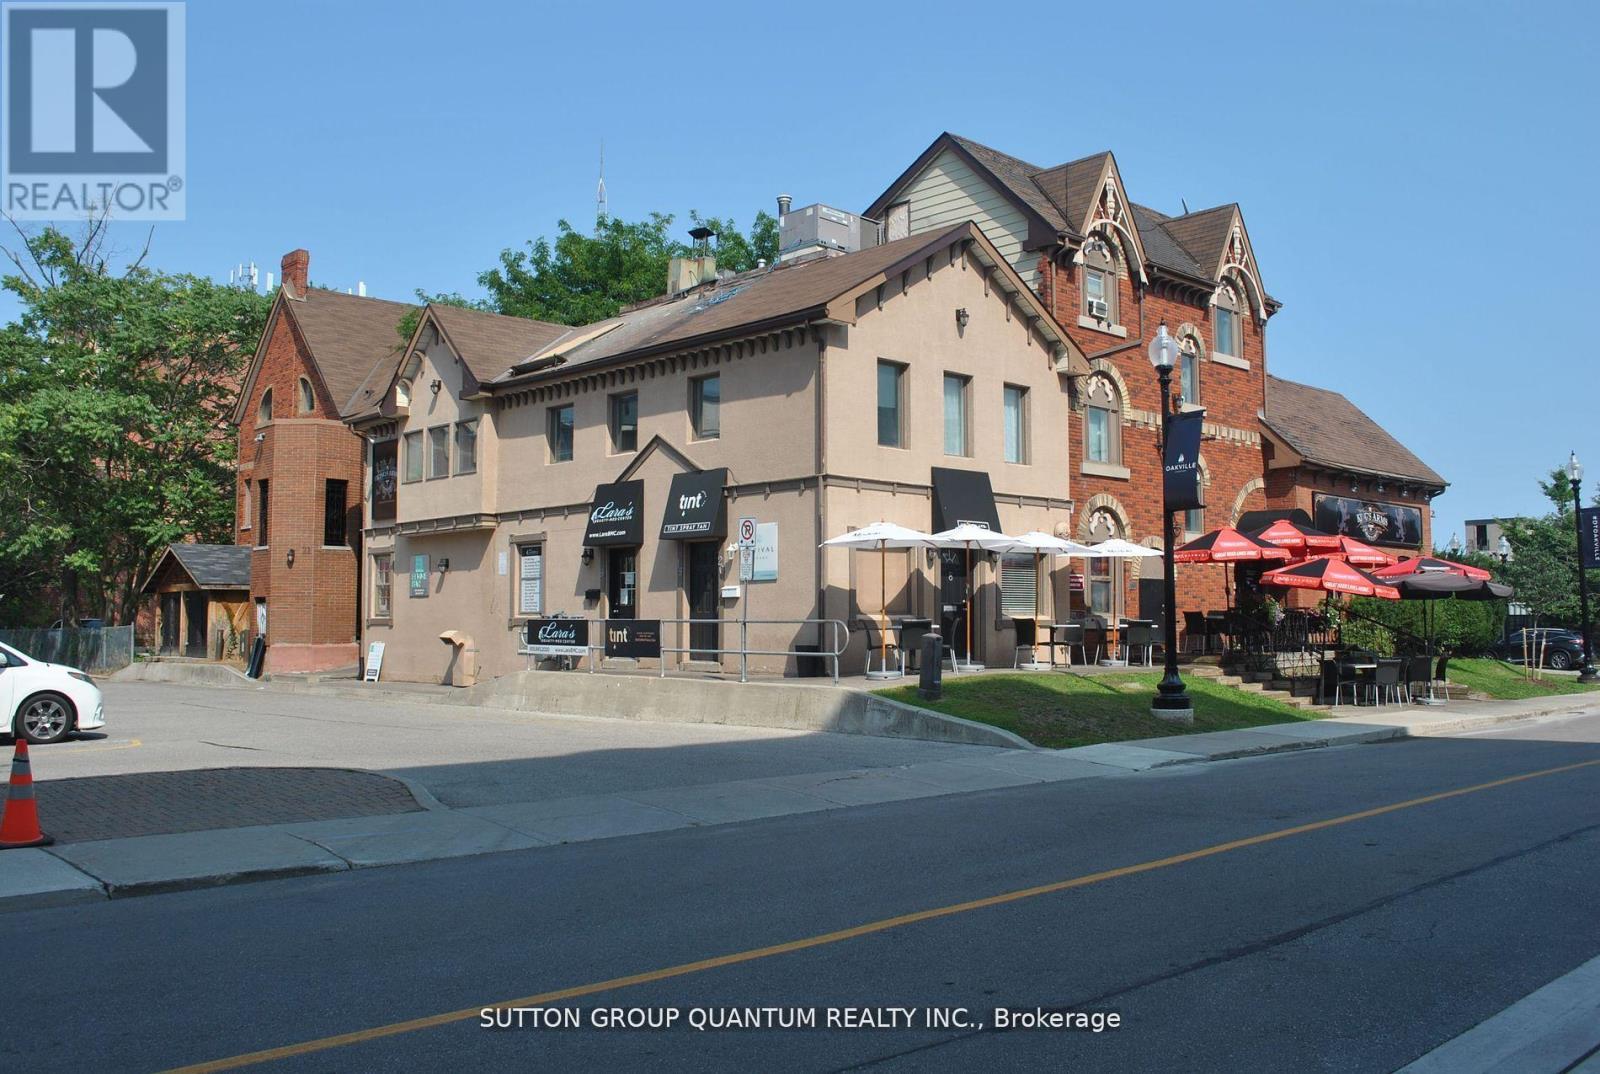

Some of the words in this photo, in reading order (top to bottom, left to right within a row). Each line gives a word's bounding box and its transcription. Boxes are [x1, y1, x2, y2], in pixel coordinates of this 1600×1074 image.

[1165, 462, 1197, 472] OAKVILLE
[591, 501, 634, 520] Lara's
[538, 621, 576, 640] Lara's
[609, 628, 628, 643] tint
